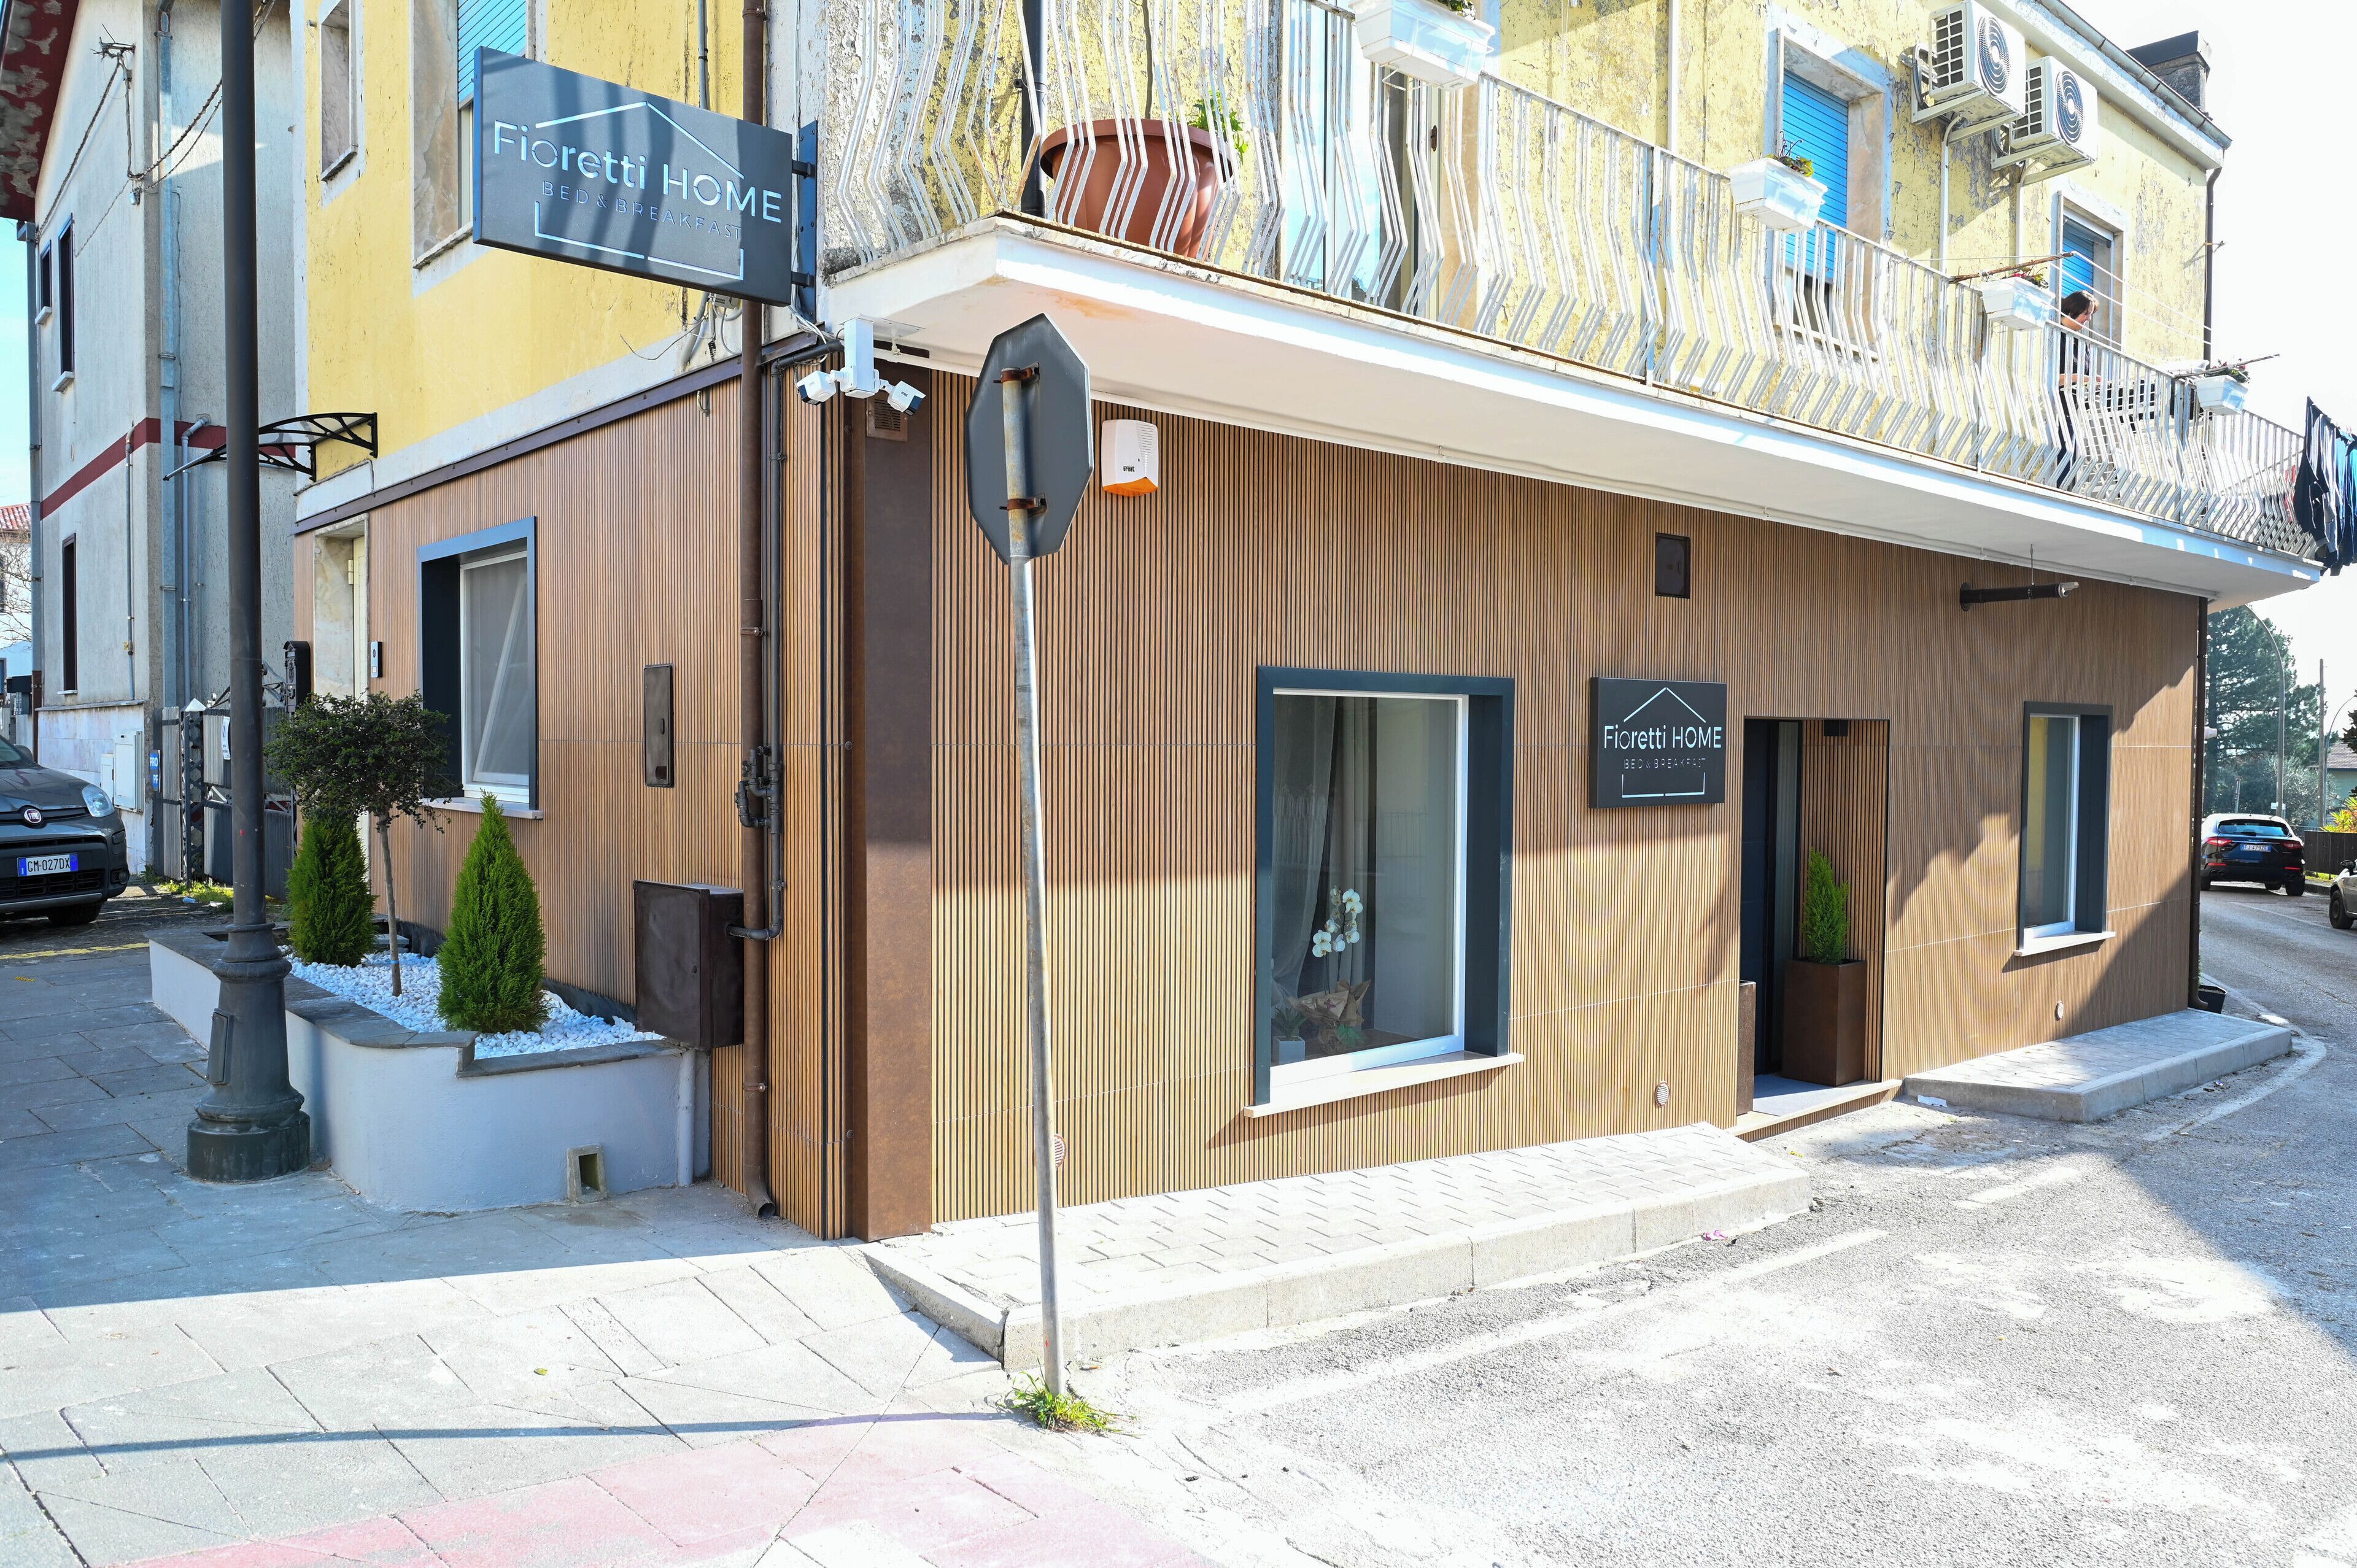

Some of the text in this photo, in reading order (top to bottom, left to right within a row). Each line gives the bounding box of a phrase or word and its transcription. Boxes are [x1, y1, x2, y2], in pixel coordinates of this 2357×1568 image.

[493, 118, 782, 223] Fioretti HOME
[1604, 724, 1722, 750] Fioretti HOME
